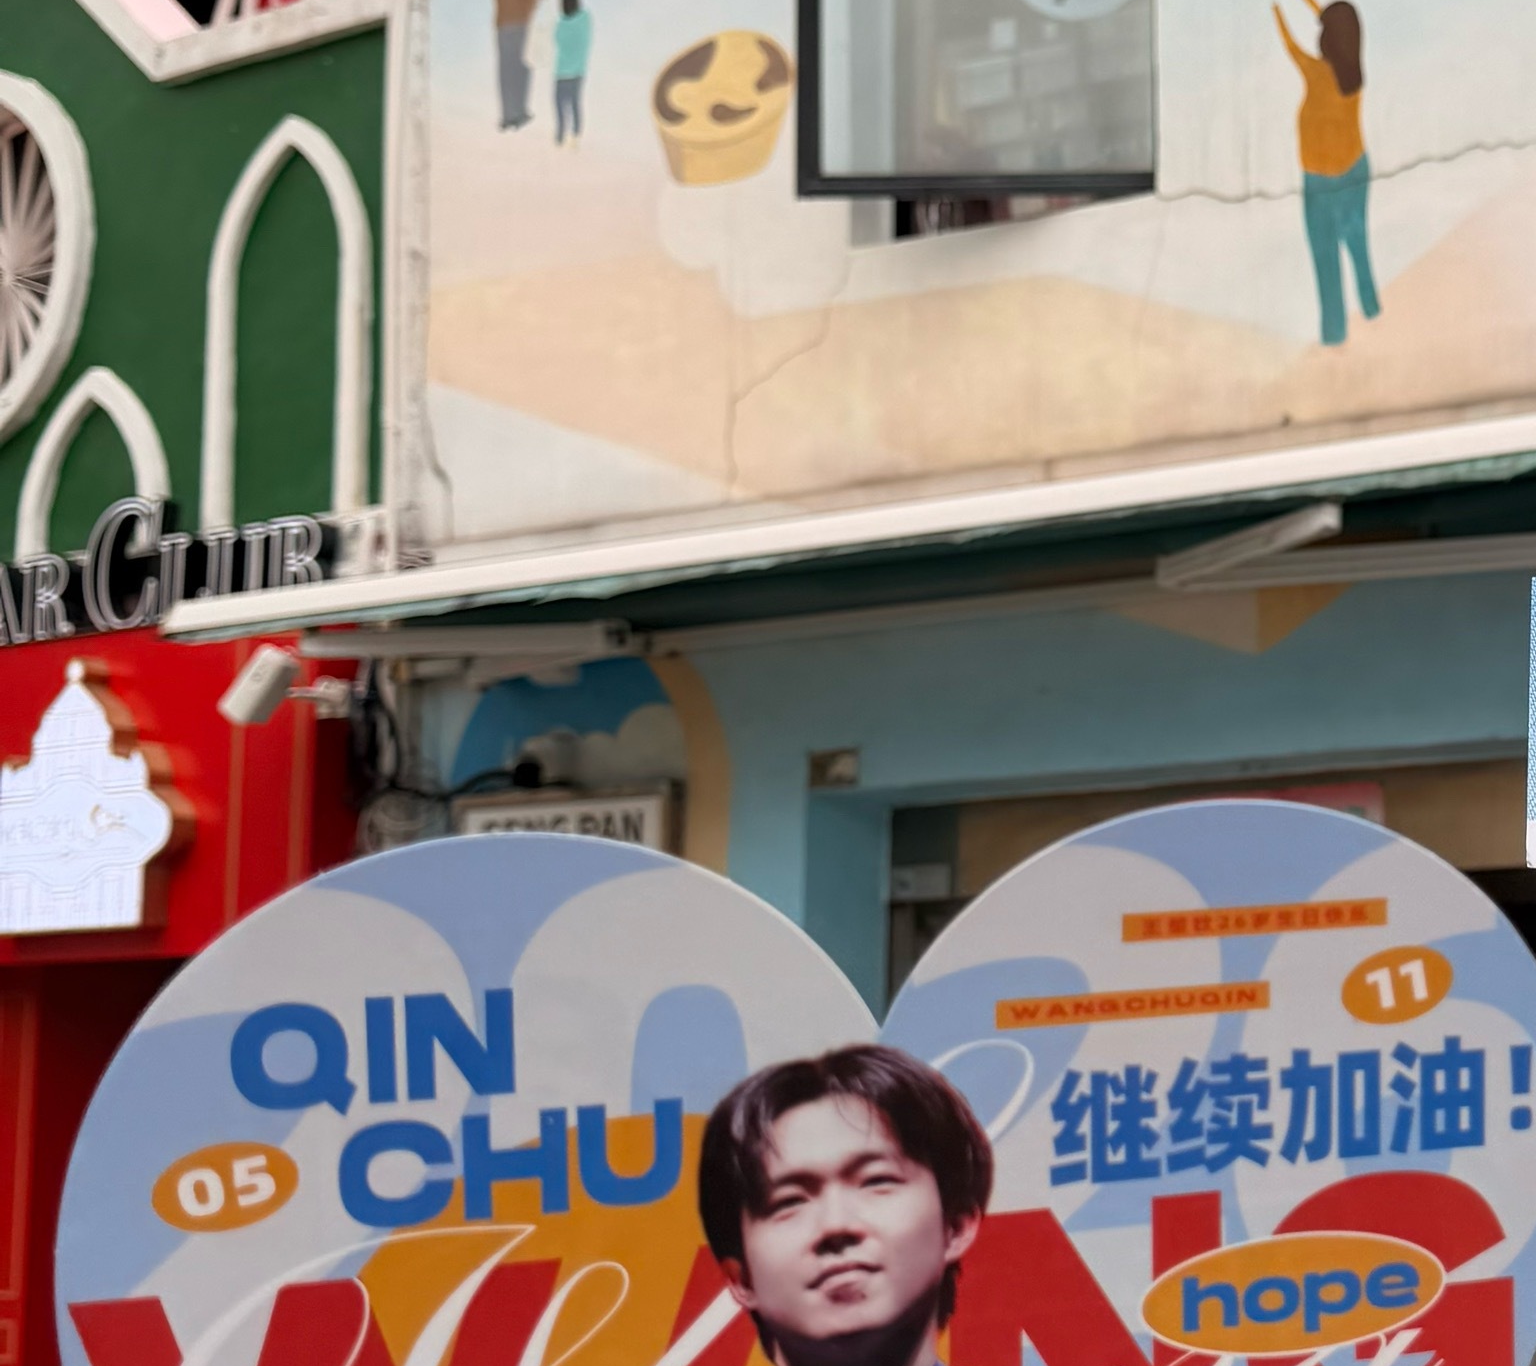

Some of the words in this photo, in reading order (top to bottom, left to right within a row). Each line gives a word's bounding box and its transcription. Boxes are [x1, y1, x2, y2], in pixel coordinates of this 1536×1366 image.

[1010, 987, 1258, 1021] WANGCHUQIN
[1365, 959, 1430, 1011] 11
[230, 987, 517, 1117] QIN
[175, 1153, 279, 1217] 05
[338, 1096, 685, 1228] CHU
[1180, 1259, 1421, 1334] hope
